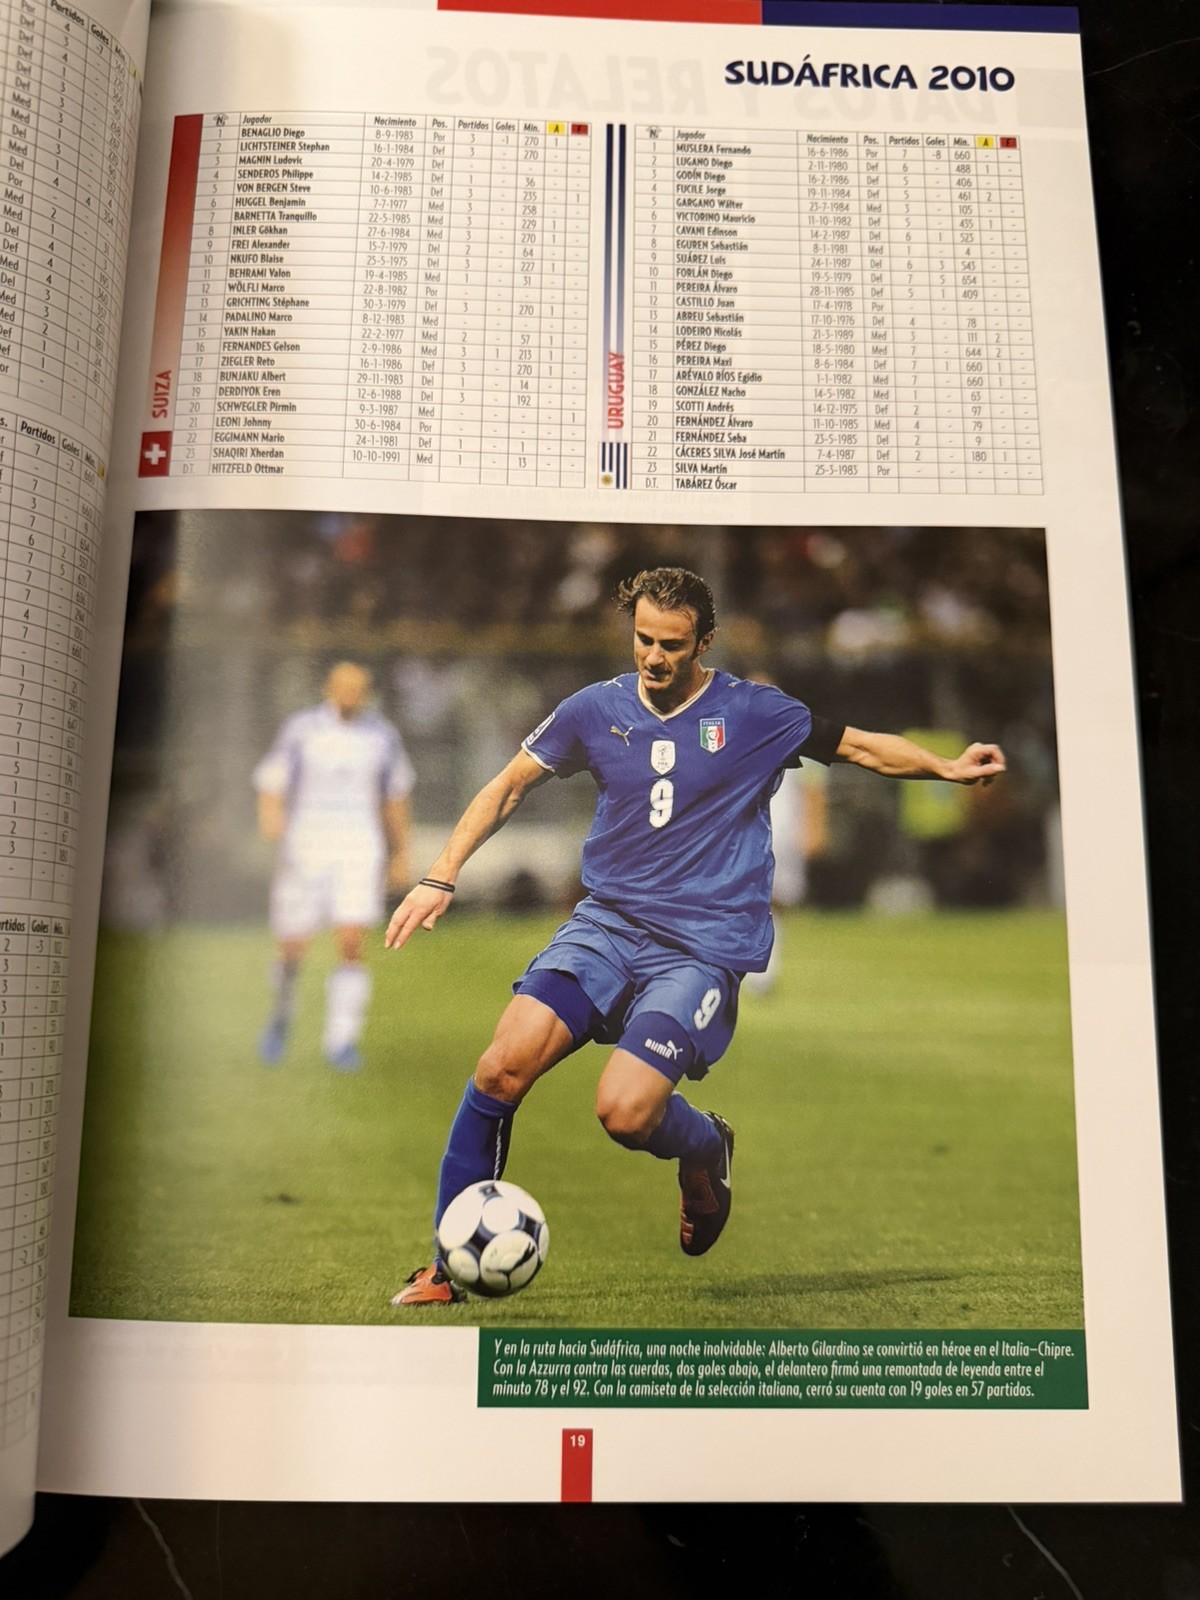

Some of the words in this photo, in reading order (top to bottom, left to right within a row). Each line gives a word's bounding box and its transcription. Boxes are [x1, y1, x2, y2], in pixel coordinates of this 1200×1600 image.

[20, 15, 35, 28] Def
[51, 0, 84, 26] Partidos
[91, 24, 109, 45] Goles
[724, 55, 918, 90] SUDÁFRICA
[928, 65, 1015, 92] 2010
[12, 91, 31, 108] Med
[242, 115, 272, 125] Jugador
[374, 117, 416, 127] Nacimiento
[432, 118, 448, 128] Pos.
[458, 120, 489, 130] Partidos
[495, 122, 515, 131] Goles
[523, 123, 540, 132] Min.
[554, 126, 559, 134] A
[241, 128, 281, 137] BENAGLIO
[283, 129, 305, 138] Diego
[375, 129, 413, 140] 8-9-1983
[433, 132, 445, 141] Por
[524, 136, 539, 146] 270
[676, 130, 706, 140] Jugador
[806, 134, 848, 144] Nacimiento
[864, 135, 879, 145] Pos.
[889, 136, 920, 145] Partidos
[926, 137, 945, 146] Goles
[953, 138, 970, 147] Min.
[982, 139, 989, 147] A
[240, 142, 296, 151] LICHTSTEINER
[298, 143, 330, 152] Stephan
[373, 144, 414, 154] 16-1-1984
[676, 144, 714, 154] MUSLERA
[716, 145, 751, 155] Fernando
[807, 148, 849, 158] 16-6-1986
[866, 148, 878, 158] Por
[955, 151, 970, 160] 660
[676, 157, 709, 167] LUGANO
[711, 158, 733, 169] Diego
[955, 164, 971, 173] 488
[238, 170, 280, 179] SENDEROS
[282, 170, 314, 179] Philippe
[237, 184, 255, 192] VON
[256, 184, 288, 192] BERGEN
[290, 184, 311, 193] Steve
[676, 184, 703, 194] FUCILE
[706, 185, 726, 195] Jorge
[676, 198, 715, 208] GARGANO
[234, 211, 276, 220] BARNETTA
[279, 212, 317, 222] Tranquillo
[676, 212, 720, 222] VICTORINO
[722, 213, 755, 223] Mauricio
[233, 226, 256, 235] INLER
[258, 226, 288, 235] Gökhan
[676, 266, 708, 278] FORLÁN
[711, 270, 733, 280] Diego
[226, 298, 270, 307] GRICHTING
[272, 298, 309, 308] Stéphane
[363, 299, 406, 310] 30-3-1979
[222, 342, 271, 351] FERNANDES
[273, 342, 300, 351] Gelson
[676, 356, 711, 366] PEREIRA
[713, 357, 732, 367] Maxi
[676, 368, 713, 382] ARÉVALO
[715, 369, 735, 382] RÍOS
[738, 372, 762, 384] Egidio
[152, 370, 172, 419] SUIZA
[607, 351, 624, 430] URUGUAY
[676, 383, 719, 396] GONZÁLEZ
[721, 387, 746, 397] Nacho
[676, 414, 725, 427] FERNÁNDEZ
[727, 414, 753, 428] Álvaro
[20, 420, 56, 445] Partidos
[61, 437, 80, 457] Goles
[213, 448, 247, 459] SHAQIRI
[250, 448, 284, 458] Xherdan
[353, 450, 400, 463] 10-10-1991
[676, 445, 711, 458] CÁCERES
[713, 448, 736, 458] SILVA
[738, 448, 756, 459] José
[759, 448, 785, 459] Martín
[212, 463, 252, 473] HITZFELD
[254, 464, 284, 474] Ottmar
[675, 463, 698, 474] SILVA
[701, 464, 727, 474] Martín
[814, 464, 858, 475] 25-3-1983
[675, 476, 712, 489] TABÁREZ
[715, 476, 737, 490] Óscar
[649, 778, 674, 828] 9
[0, 918, 25, 931] rtidos
[694, 988, 721, 1030] 9
[494, 1339, 502, 1354] Y
[504, 1343, 516, 1354] en
[520, 1339, 531, 1354] la
[533, 1341, 555, 1355] ruta
[559, 1339, 586, 1355] hacia
[590, 1340, 642, 1358] Sudáfrica,
[646, 1344, 666, 1355] una
[670, 1340, 700, 1355] noche
[704, 1340, 766, 1356] inolvidable:
[769, 1341, 808, 1356] Alberto
[812, 1341, 860, 1356] Gilardino
[863, 1344, 874, 1356] se
[877, 1342, 922, 1356] convirtió
[926, 1345, 938, 1356] en
[942, 1342, 970, 1356] héroe
[974, 1345, 986, 1356] en
[990, 1342, 999, 1356] el
[494, 1360, 513, 1374] Con
[516, 1360, 526, 1374] la
[529, 1360, 570, 1375] Azzurra
[574, 1362, 608, 1376] contra
[611, 1360, 626, 1376] las
[629, 1360, 672, 1378] cuerdas,
[676, 1360, 695, 1376] dos
[698, 1360, 726, 1380] goles
[728, 1360, 761, 1380] abajo,
[765, 1360, 774, 1376] el
[778, 1362, 828, 1376] delantero
[831, 1362, 859, 1379] firmó
[862, 1366, 881, 1376] una
[885, 1362, 942, 1376] remontada
[946, 1362, 958, 1376] de
[961, 1362, 1000, 1380] leyenda
[1004, 1364, 1032, 1376] entre
[1035, 1362, 1044, 1376] el
[493, 1382, 531, 1394] minuto
[535, 1380, 548, 1394] 78
[551, 1384, 558, 1398] y
[560, 1380, 570, 1394] el
[573, 1380, 590, 1395] 92.
[594, 1380, 614, 1395] Con
[616, 1380, 626, 1395] la
[630, 1381, 676, 1395] camiseta
[680, 1380, 692, 1395] de
[696, 1380, 704, 1396] la
[708, 1380, 755, 1396] selección
[758, 1381, 802, 1398] italiana,
[806, 1382, 832, 1396] cerró
[836, 1386, 847, 1396] su
[850, 1383, 885, 1396] cuenta
[889, 1386, 906, 1396] con
[910, 1382, 922, 1396] 19
[925, 1382, 952, 1398] goles
[956, 1386, 968, 1396] en
[971, 1382, 984, 1396] 57
[987, 1382, 1034, 1399] partidos.
[570, 1435, 586, 1447] 19
